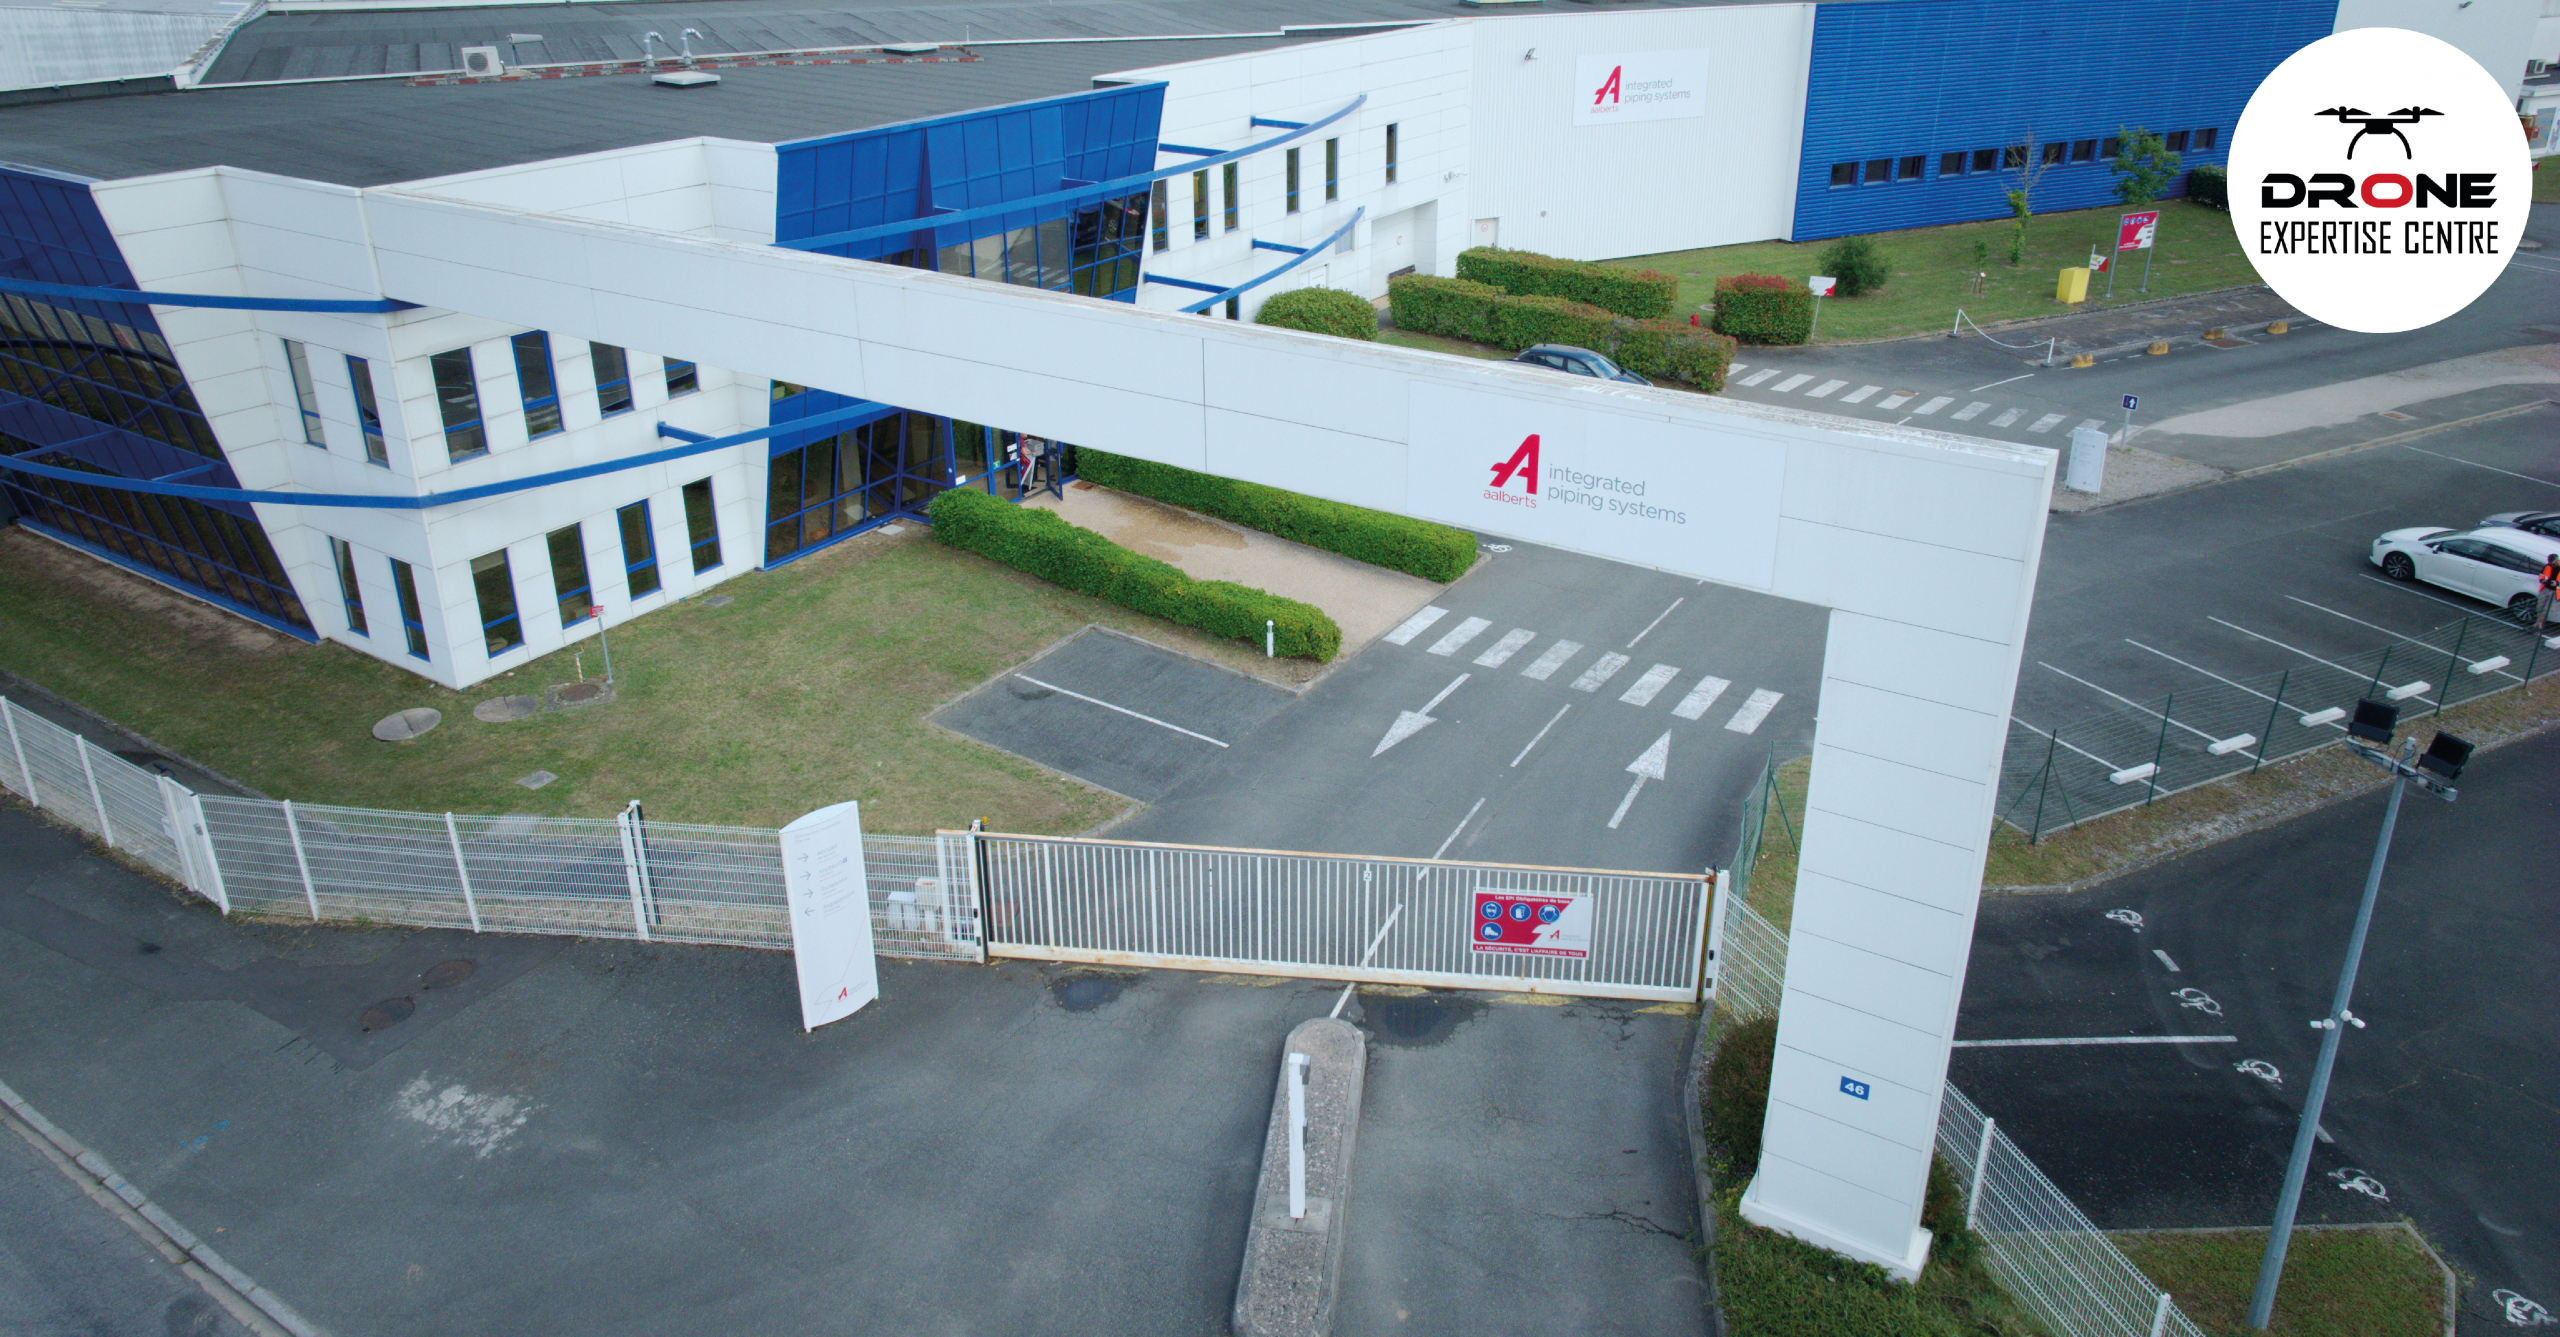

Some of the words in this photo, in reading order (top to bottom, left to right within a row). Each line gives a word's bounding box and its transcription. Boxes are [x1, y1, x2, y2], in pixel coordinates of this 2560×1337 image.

[1625, 78, 1673, 92] integrated
[1624, 92, 1652, 104] piping
[1654, 89, 1691, 102] systems
[1590, 105, 1619, 114] aalberts
[1549, 463, 1646, 497] integrated
[1483, 489, 1537, 509] aalberts
[1547, 485, 1604, 512] piping
[1608, 497, 1687, 525] systems
[1364, 871, 1371, 880] 2
[1844, 1082, 1865, 1096] 46
